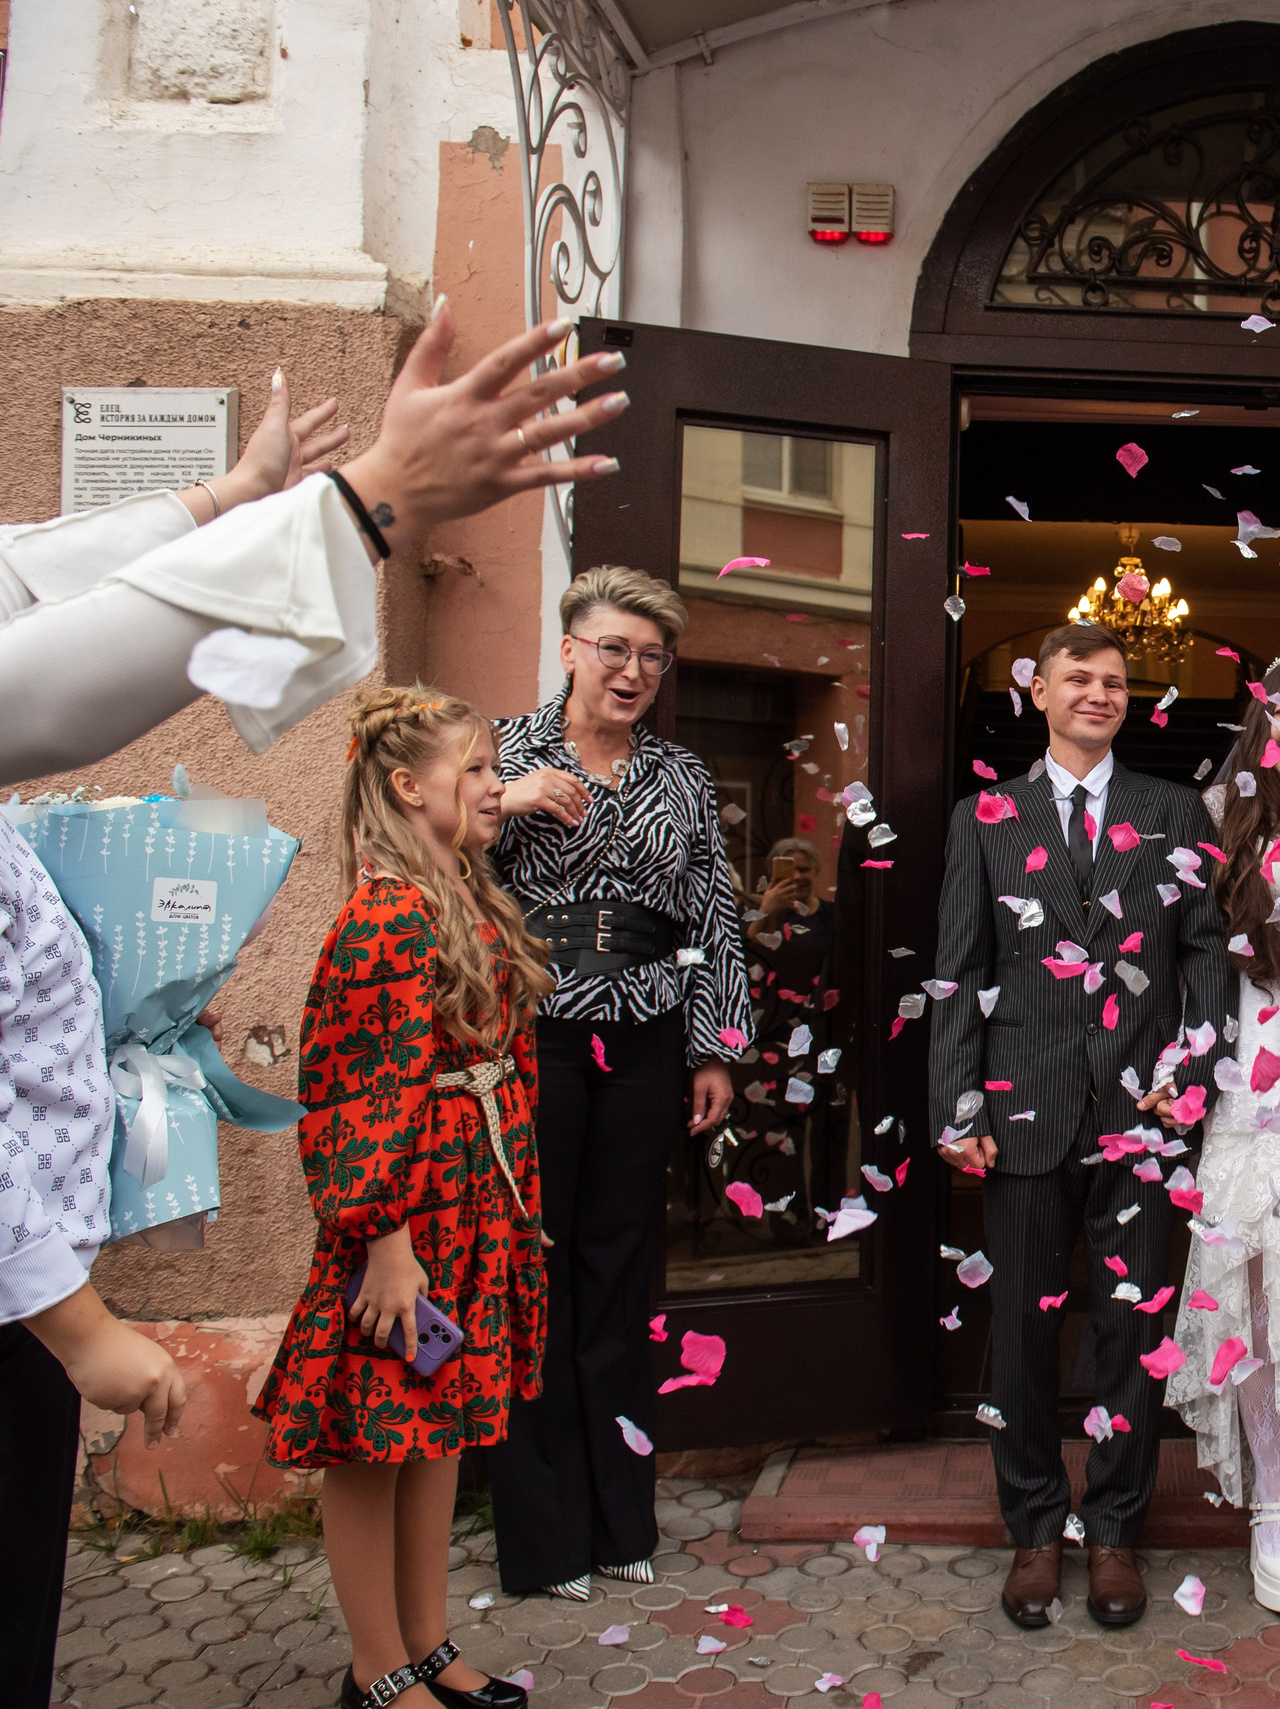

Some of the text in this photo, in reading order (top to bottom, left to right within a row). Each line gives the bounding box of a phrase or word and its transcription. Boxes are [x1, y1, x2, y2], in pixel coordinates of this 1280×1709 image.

[100, 414, 216, 423] ИСТОРИЯ ЗА КАЖДЫМ ДОМОМ
[75, 433, 162, 442] Дом Черникиных
